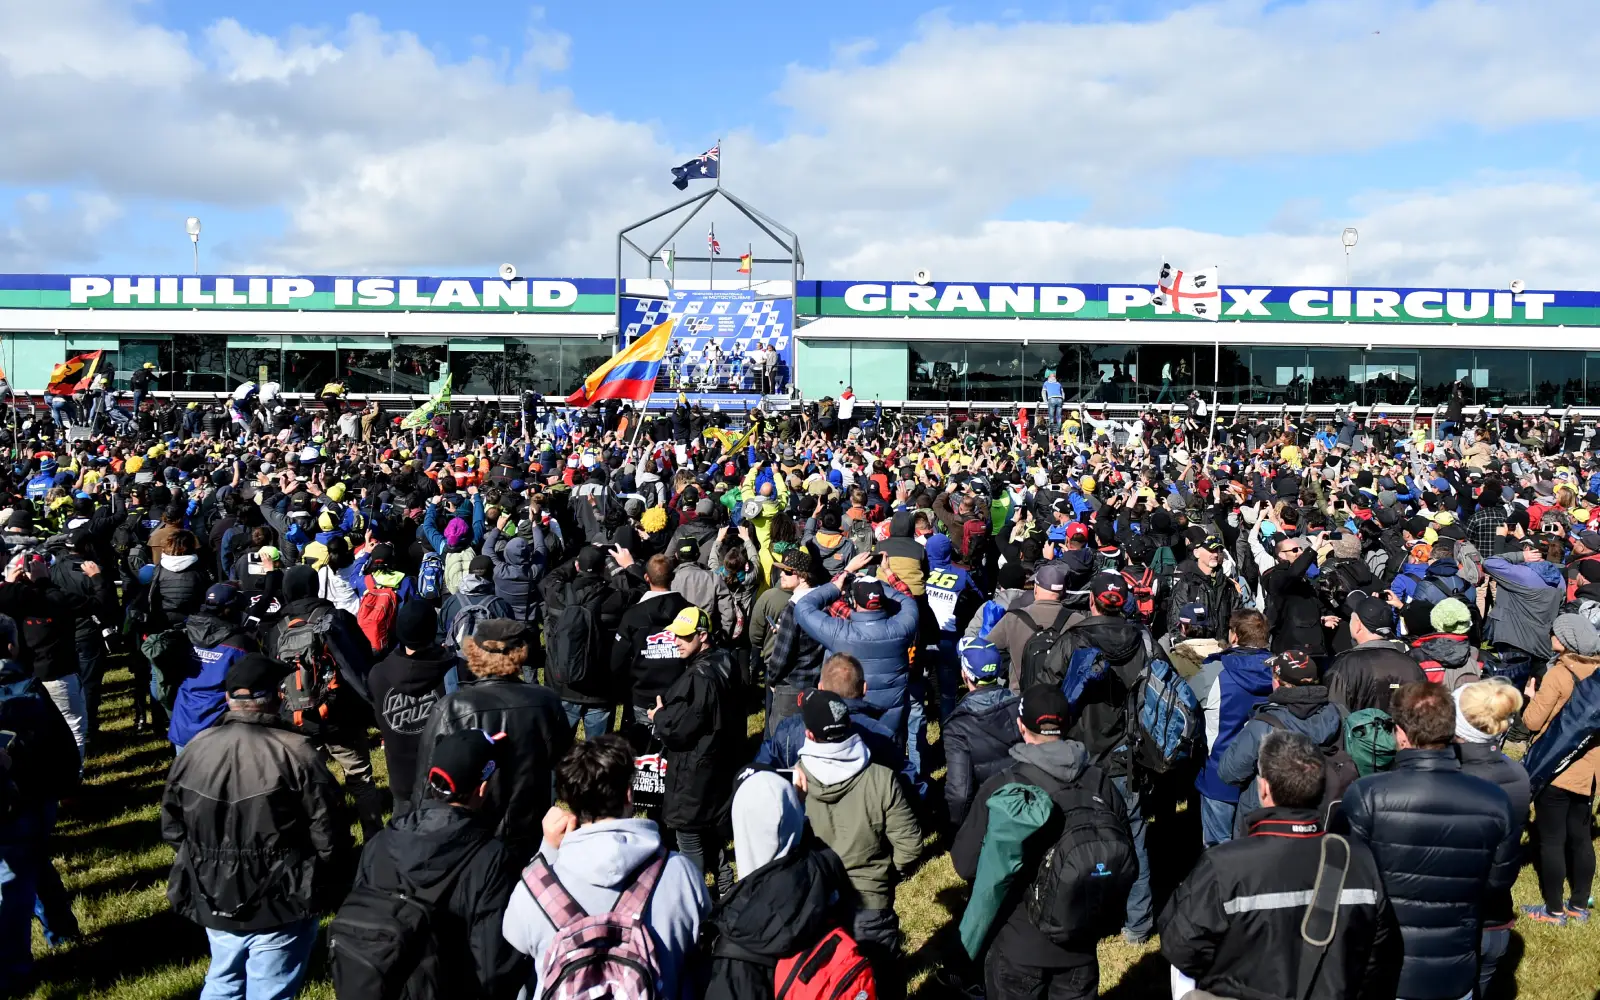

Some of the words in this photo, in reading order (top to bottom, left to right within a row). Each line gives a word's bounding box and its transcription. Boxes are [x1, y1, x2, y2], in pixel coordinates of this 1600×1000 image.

[70, 277, 315, 305] PHILLIP
[335, 279, 578, 307] ISLAND
[844, 284, 1086, 313] GRAND
[1107, 287, 1272, 316] PX
[1288, 289, 1555, 320] CIRCUIT
[926, 570, 959, 589] 46
[926, 589, 954, 602] AMAHA
[981, 664, 997, 672] 46
[390, 700, 434, 729] CRUZ
[633, 784, 654, 793] RAND
[1292, 824, 1317, 833] Canon
